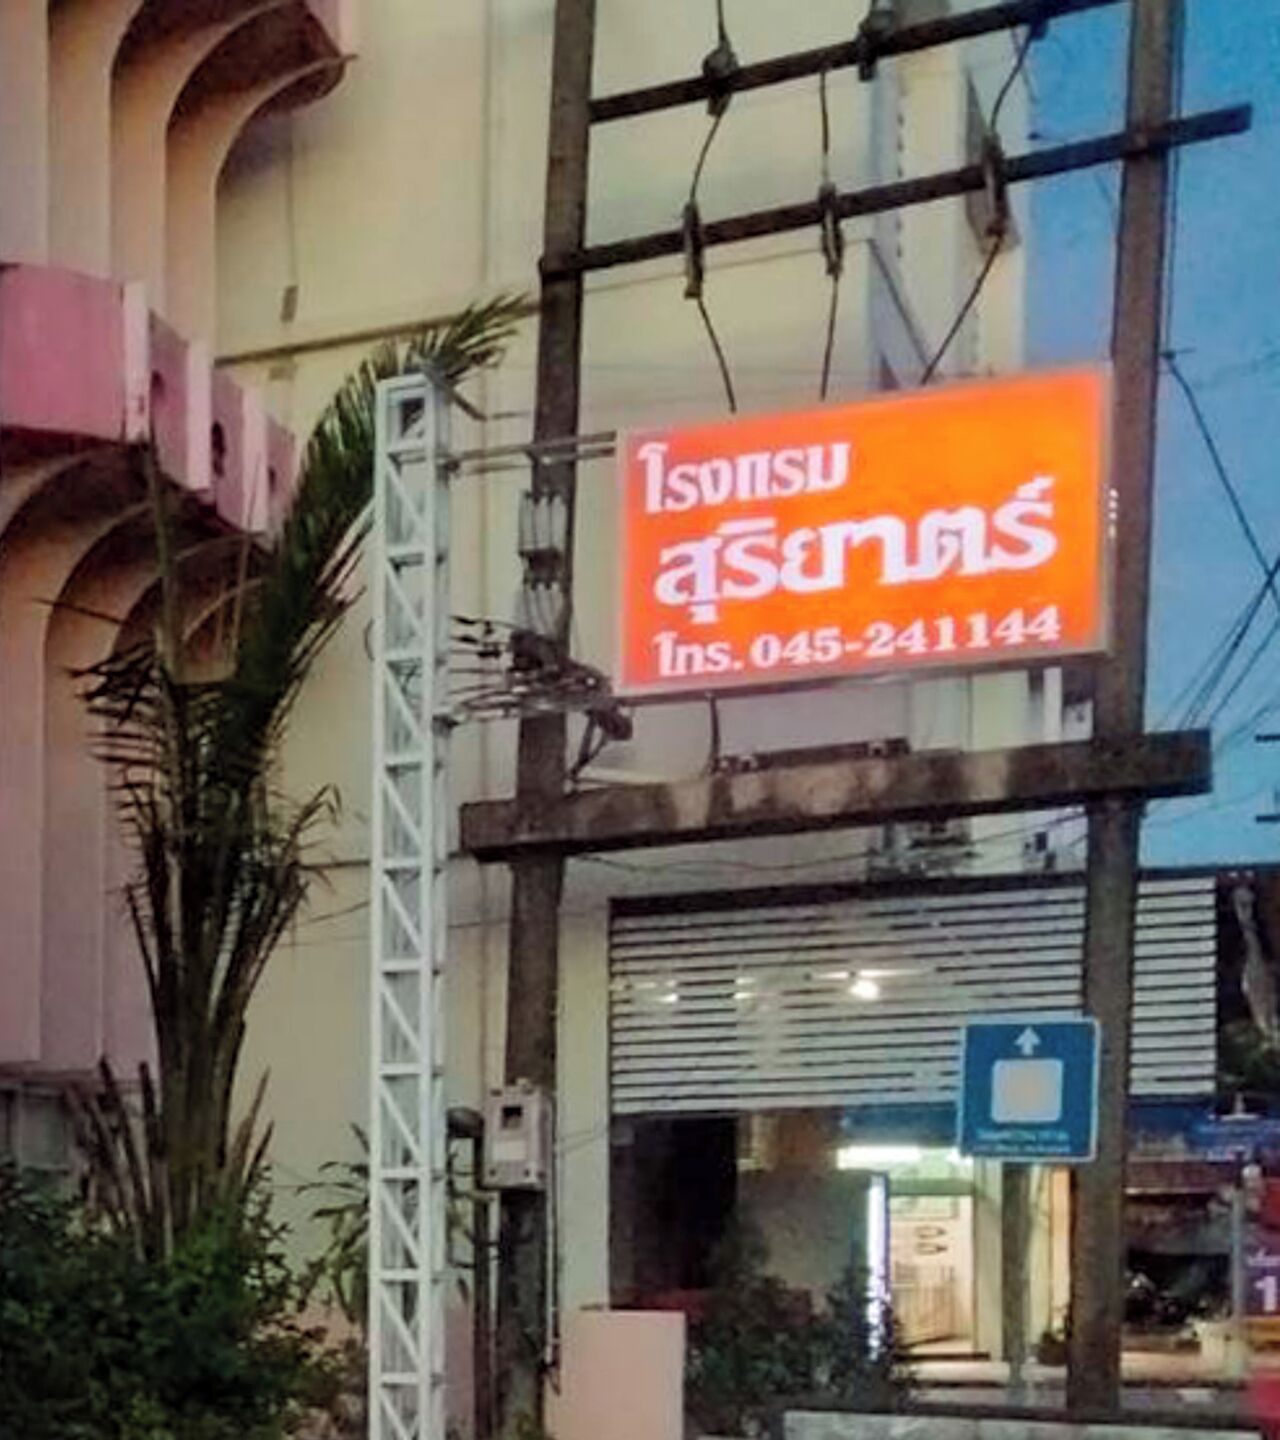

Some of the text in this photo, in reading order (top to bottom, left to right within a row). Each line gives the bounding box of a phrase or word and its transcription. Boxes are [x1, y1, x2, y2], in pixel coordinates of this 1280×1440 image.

[654, 476, 1057, 623] สุริยาตร์
[750, 604, 1061, 669] 045-241144
